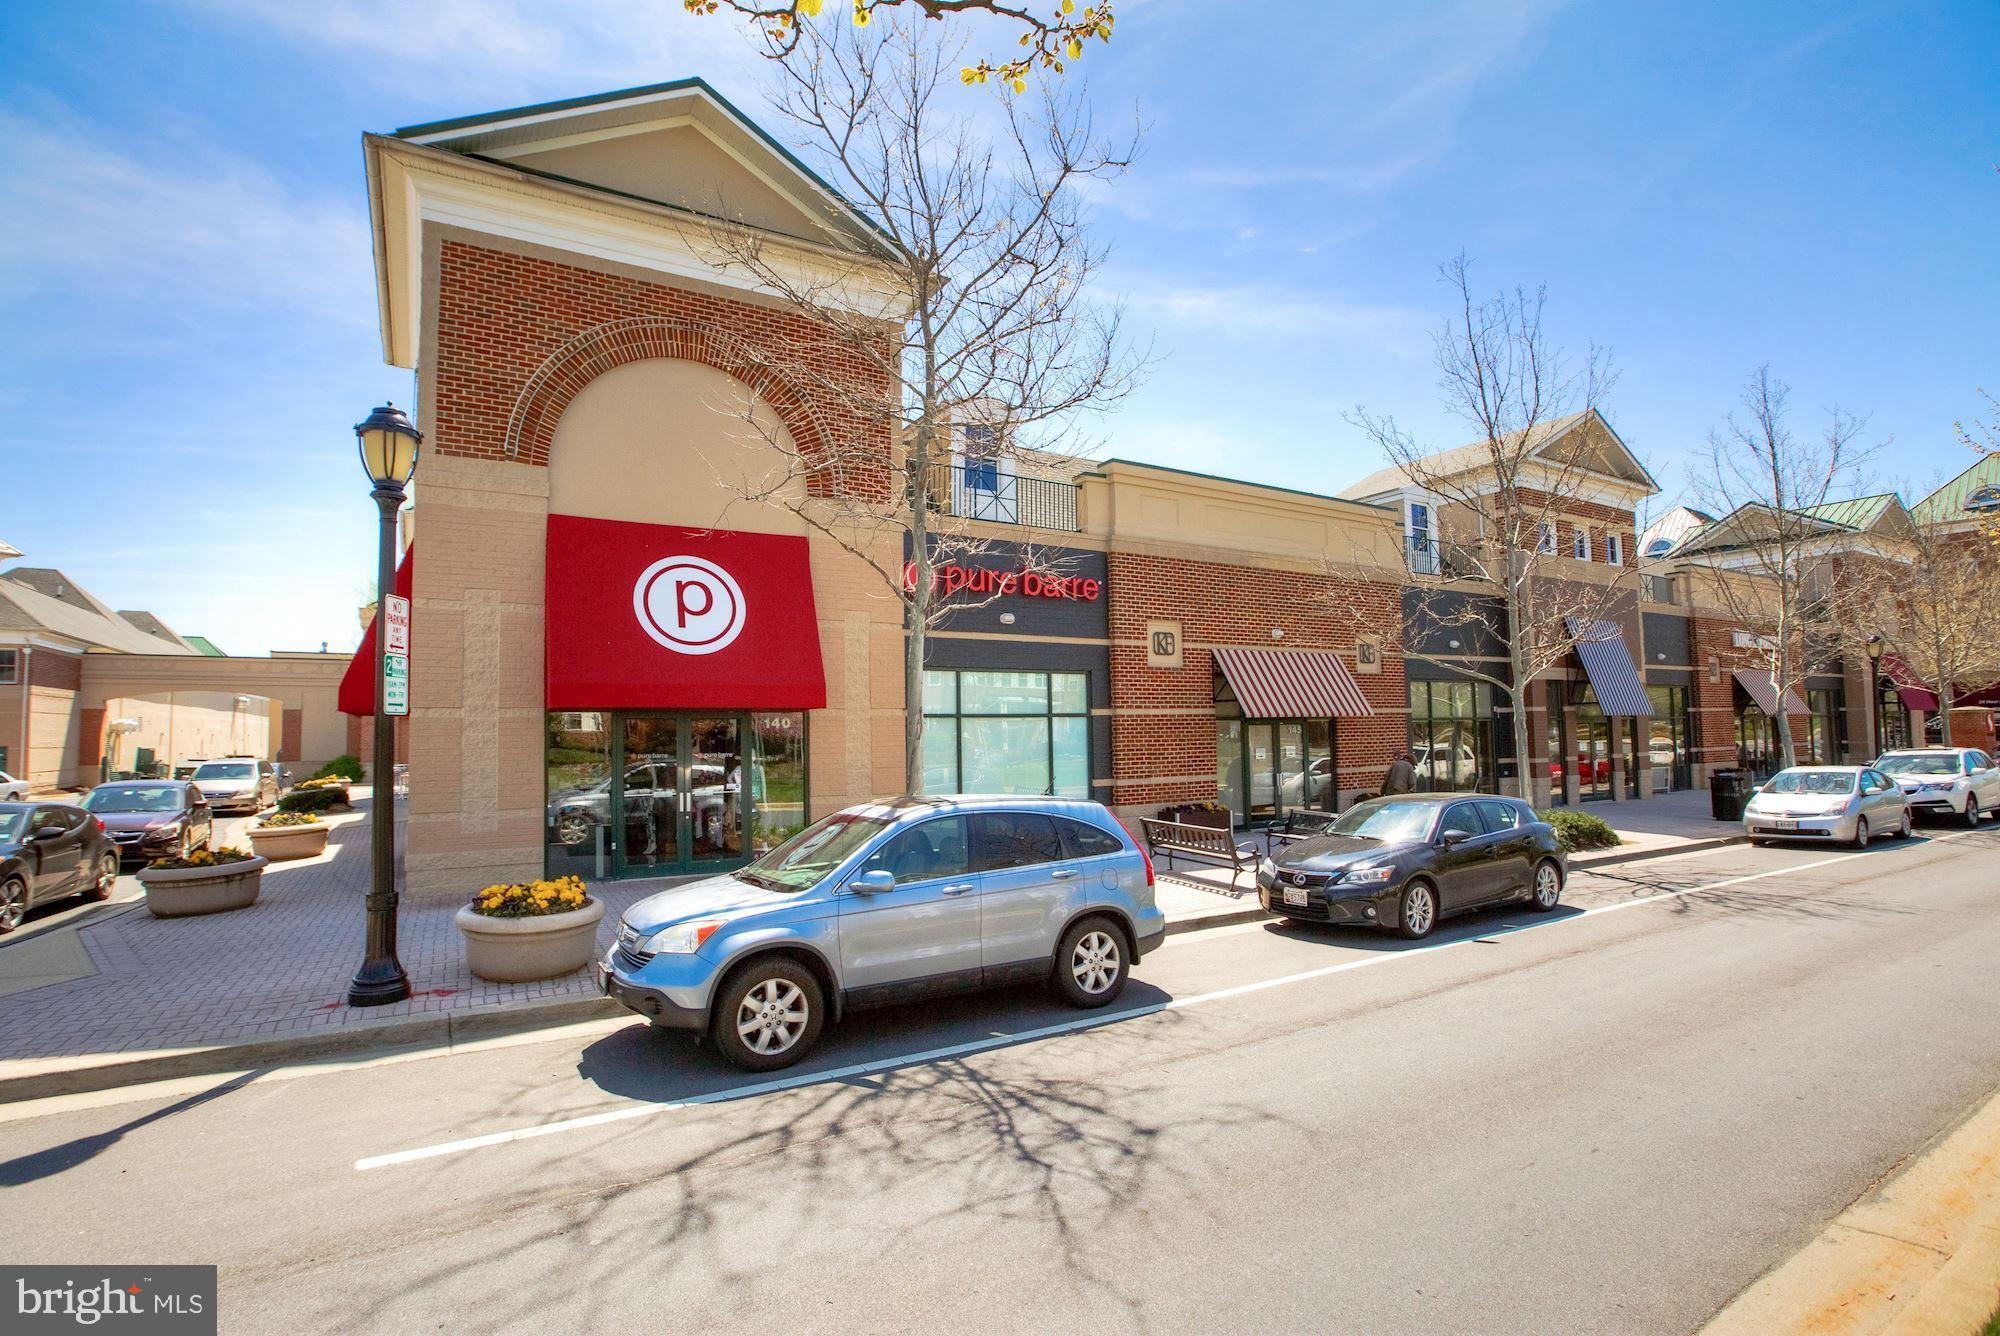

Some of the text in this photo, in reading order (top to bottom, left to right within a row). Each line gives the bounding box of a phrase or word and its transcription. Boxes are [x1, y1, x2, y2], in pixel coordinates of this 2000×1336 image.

[945, 565, 1099, 601] pure barre
[393, 600, 402, 613] NO
[675, 580, 713, 628] p
[387, 613, 408, 627] PARKING
[393, 626, 402, 634] ANY
[391, 634, 402, 644] TIME
[386, 658, 392, 674] 2
[763, 717, 792, 729] 140
[1288, 724, 1302, 734] 145
